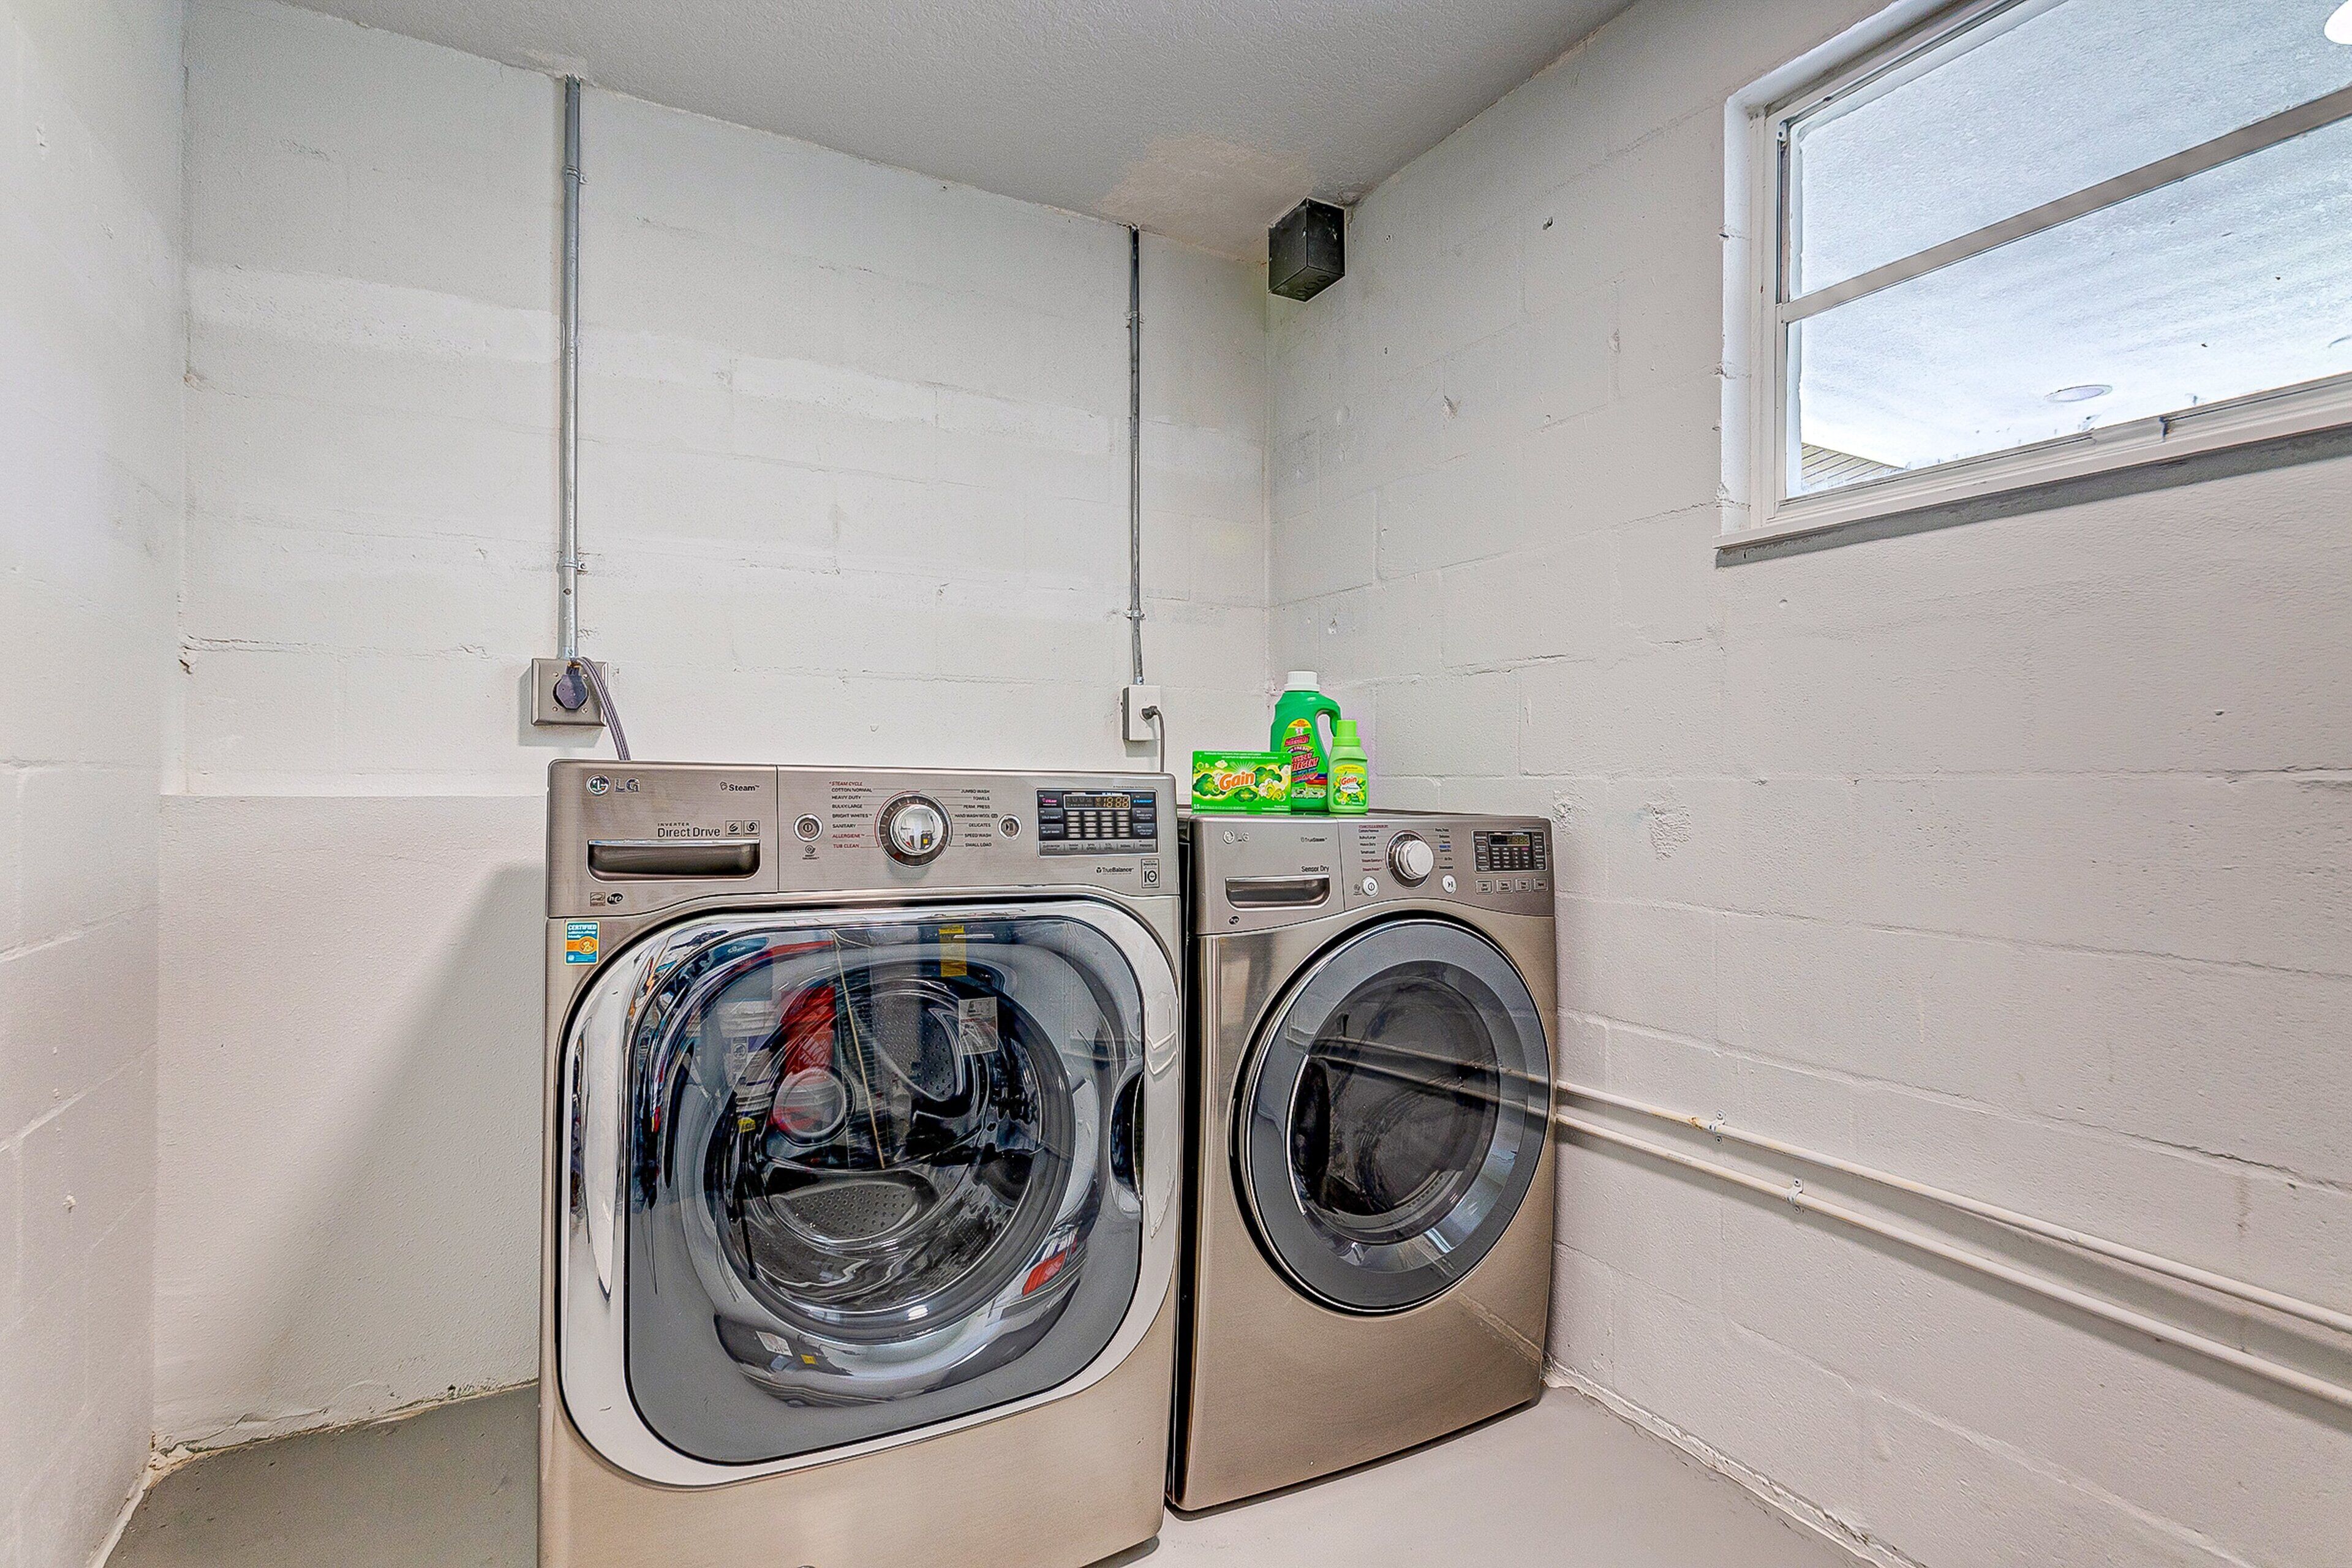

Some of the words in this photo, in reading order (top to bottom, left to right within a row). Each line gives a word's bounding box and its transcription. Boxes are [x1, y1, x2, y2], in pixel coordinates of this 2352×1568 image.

[614, 778, 640, 793] LG
[1219, 771, 1255, 790] Gain
[1341, 776, 1357, 785] Gain
[657, 827, 690, 837] Direct
[692, 827, 720, 837] Drive
[1144, 870, 1158, 883] 10
